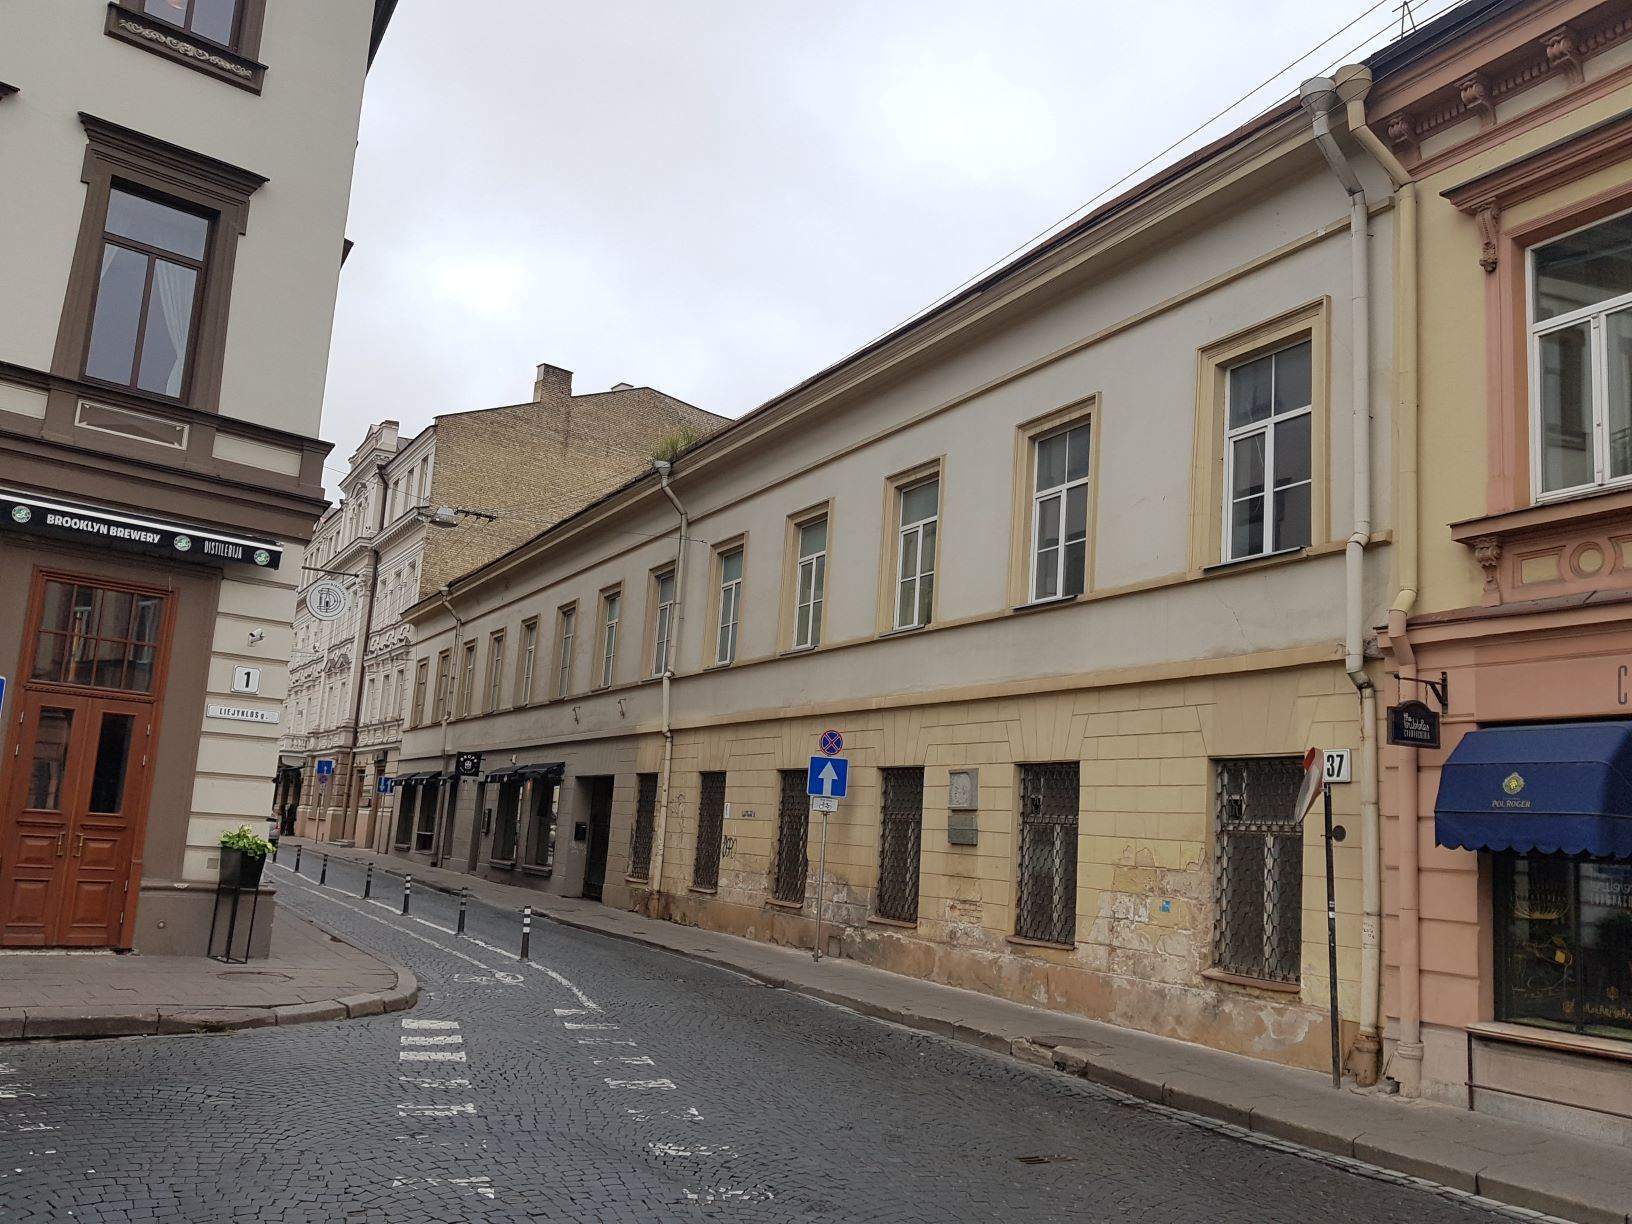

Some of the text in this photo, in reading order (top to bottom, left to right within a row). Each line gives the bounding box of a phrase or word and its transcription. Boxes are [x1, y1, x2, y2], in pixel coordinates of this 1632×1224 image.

[46, 513, 161, 543] BROOKLYN BREWERY
[204, 540, 243, 559] DISTILERIJA
[244, 671, 251, 689] 1
[219, 708, 260, 719] LIEJYKLOS
[1326, 754, 1345, 778] 37
[1505, 799, 1531, 808] ROGER
